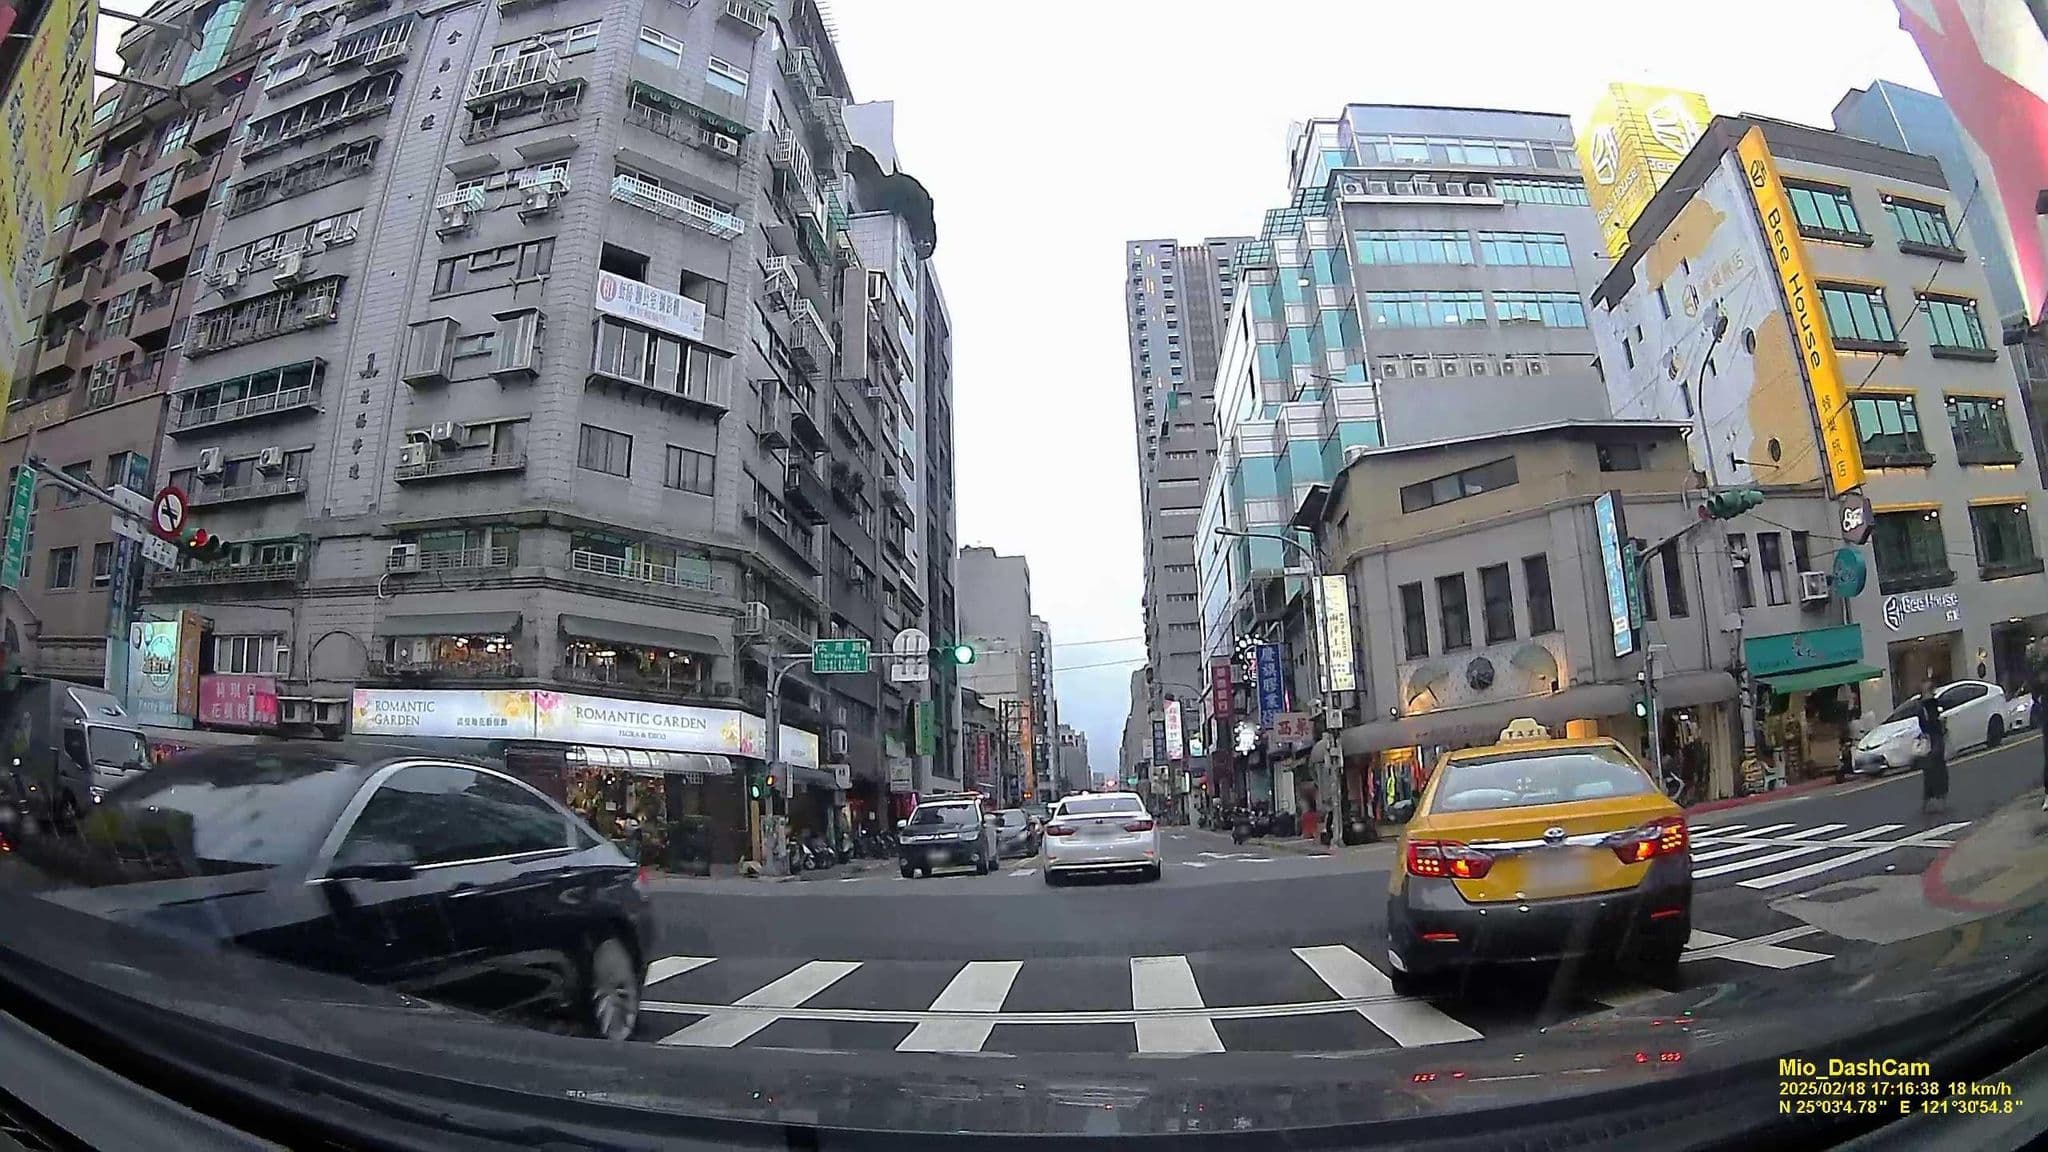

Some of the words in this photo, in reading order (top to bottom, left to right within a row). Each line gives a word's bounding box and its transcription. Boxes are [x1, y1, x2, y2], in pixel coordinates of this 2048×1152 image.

[1768, 209, 1790, 265] Bee
[1789, 272, 1823, 370] House
[1901, 595, 1926, 613] Bee
[1925, 592, 1959, 609] House
[375, 700, 435, 713] ROMANTIC
[374, 713, 420, 726] GARDEN
[576, 706, 650, 725] ROMANTIC
[652, 714, 707, 729] GARDEN
